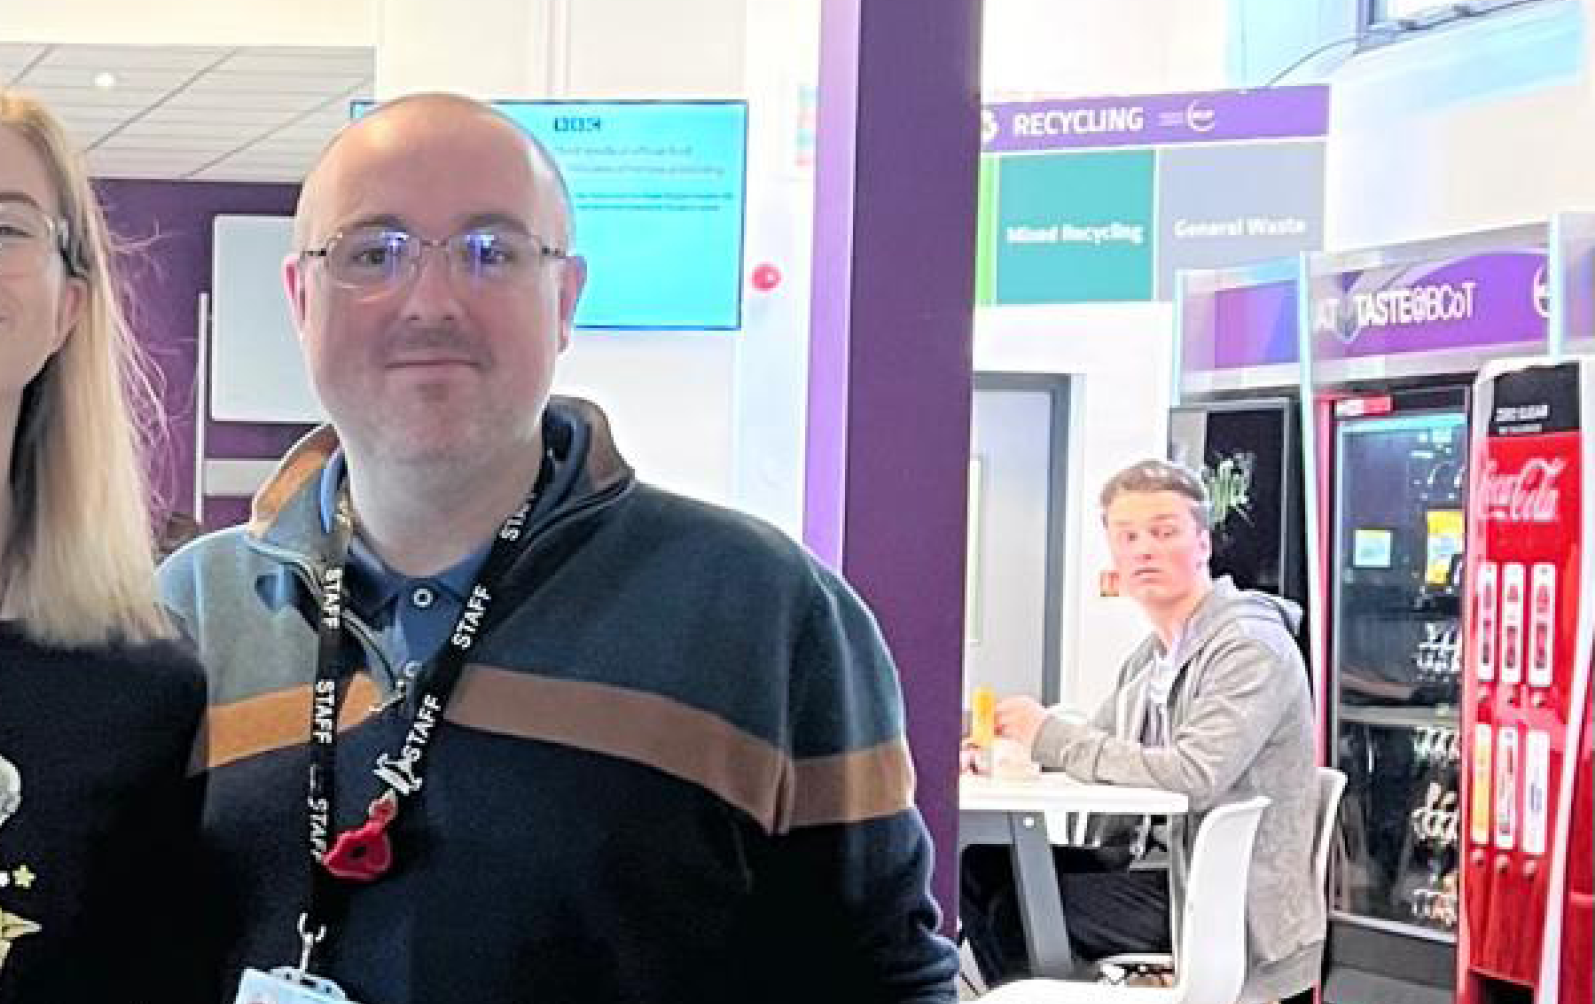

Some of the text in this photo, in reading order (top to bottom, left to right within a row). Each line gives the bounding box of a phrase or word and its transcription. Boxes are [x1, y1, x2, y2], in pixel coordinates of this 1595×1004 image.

[1013, 106, 1144, 137] RECYCLING
[1006, 221, 1145, 245] Mixed Recycling
[1173, 217, 1307, 238] General Waste
[322, 568, 343, 629] STAFF
[451, 583, 491, 649] STAFF
[315, 680, 335, 744] STAFF
[401, 694, 441, 762] STAFF
